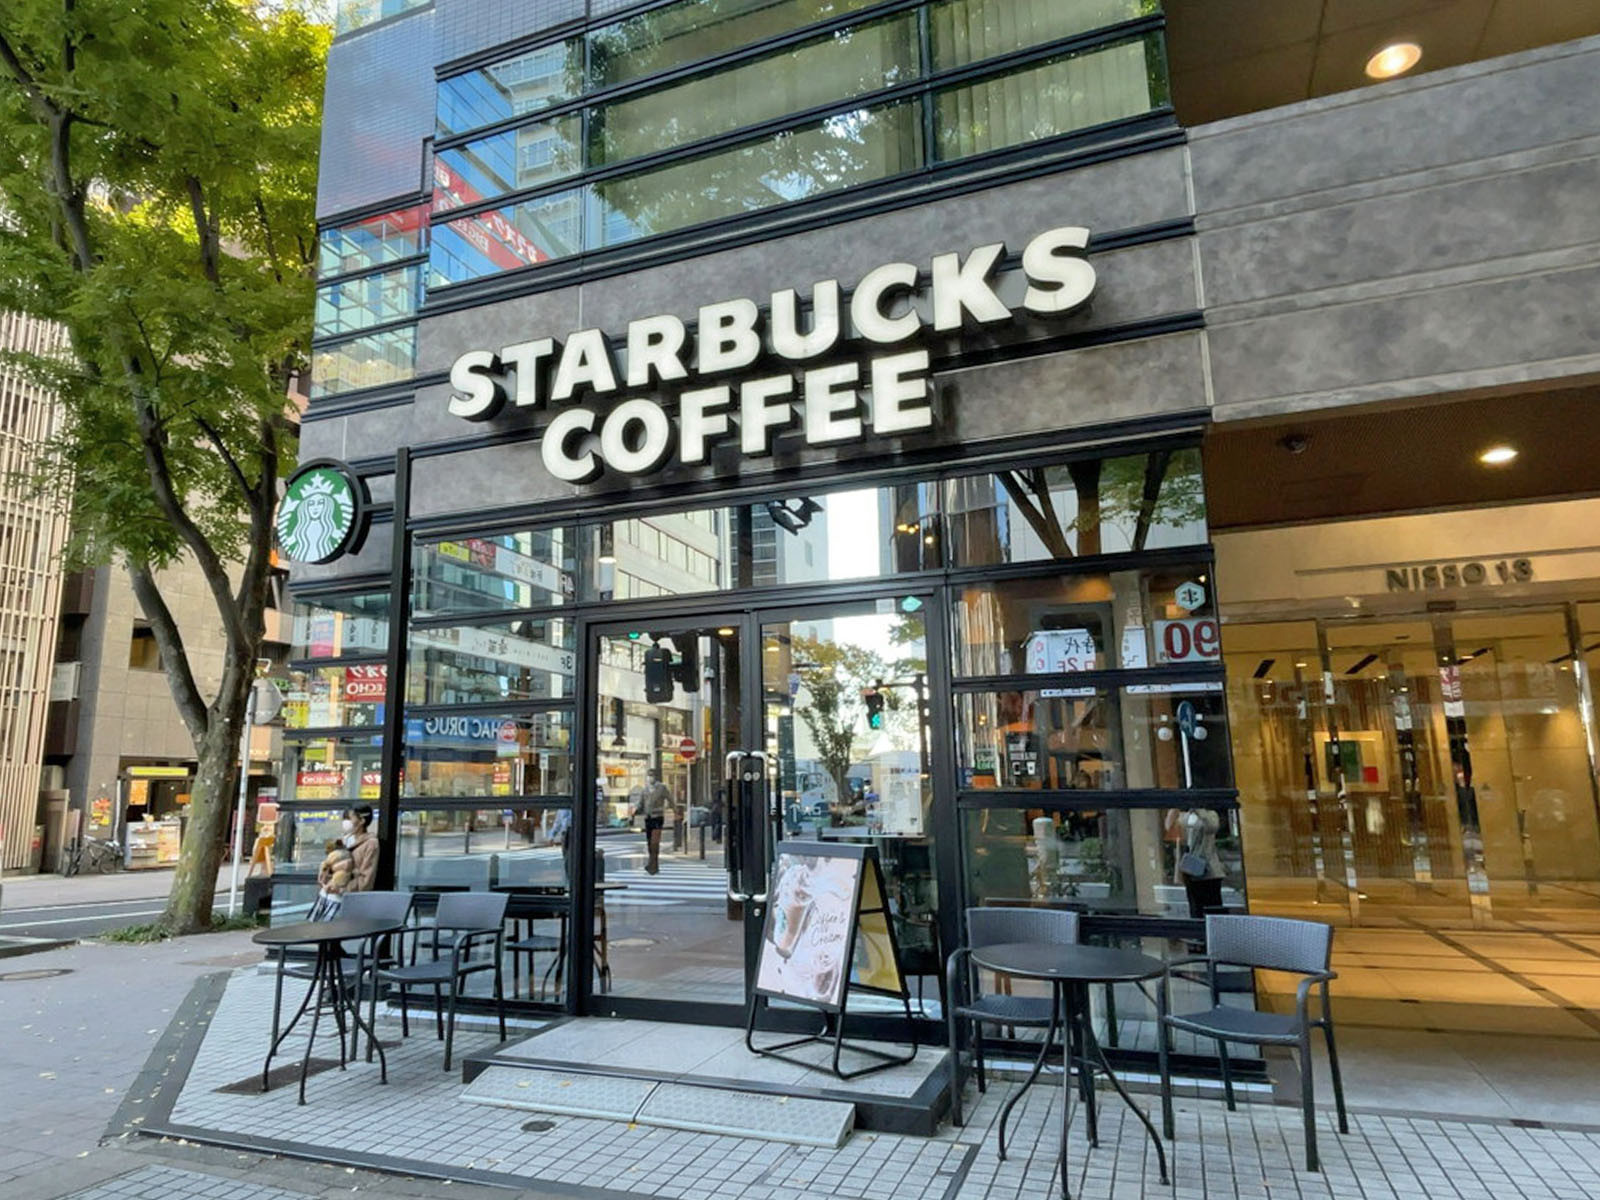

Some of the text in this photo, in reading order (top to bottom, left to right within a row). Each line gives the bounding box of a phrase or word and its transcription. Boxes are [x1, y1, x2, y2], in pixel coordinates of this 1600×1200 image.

[448, 226, 1098, 418] STARBUCKS
[540, 350, 933, 483] COFFEE
[1386, 562, 1487, 592] NISSO
